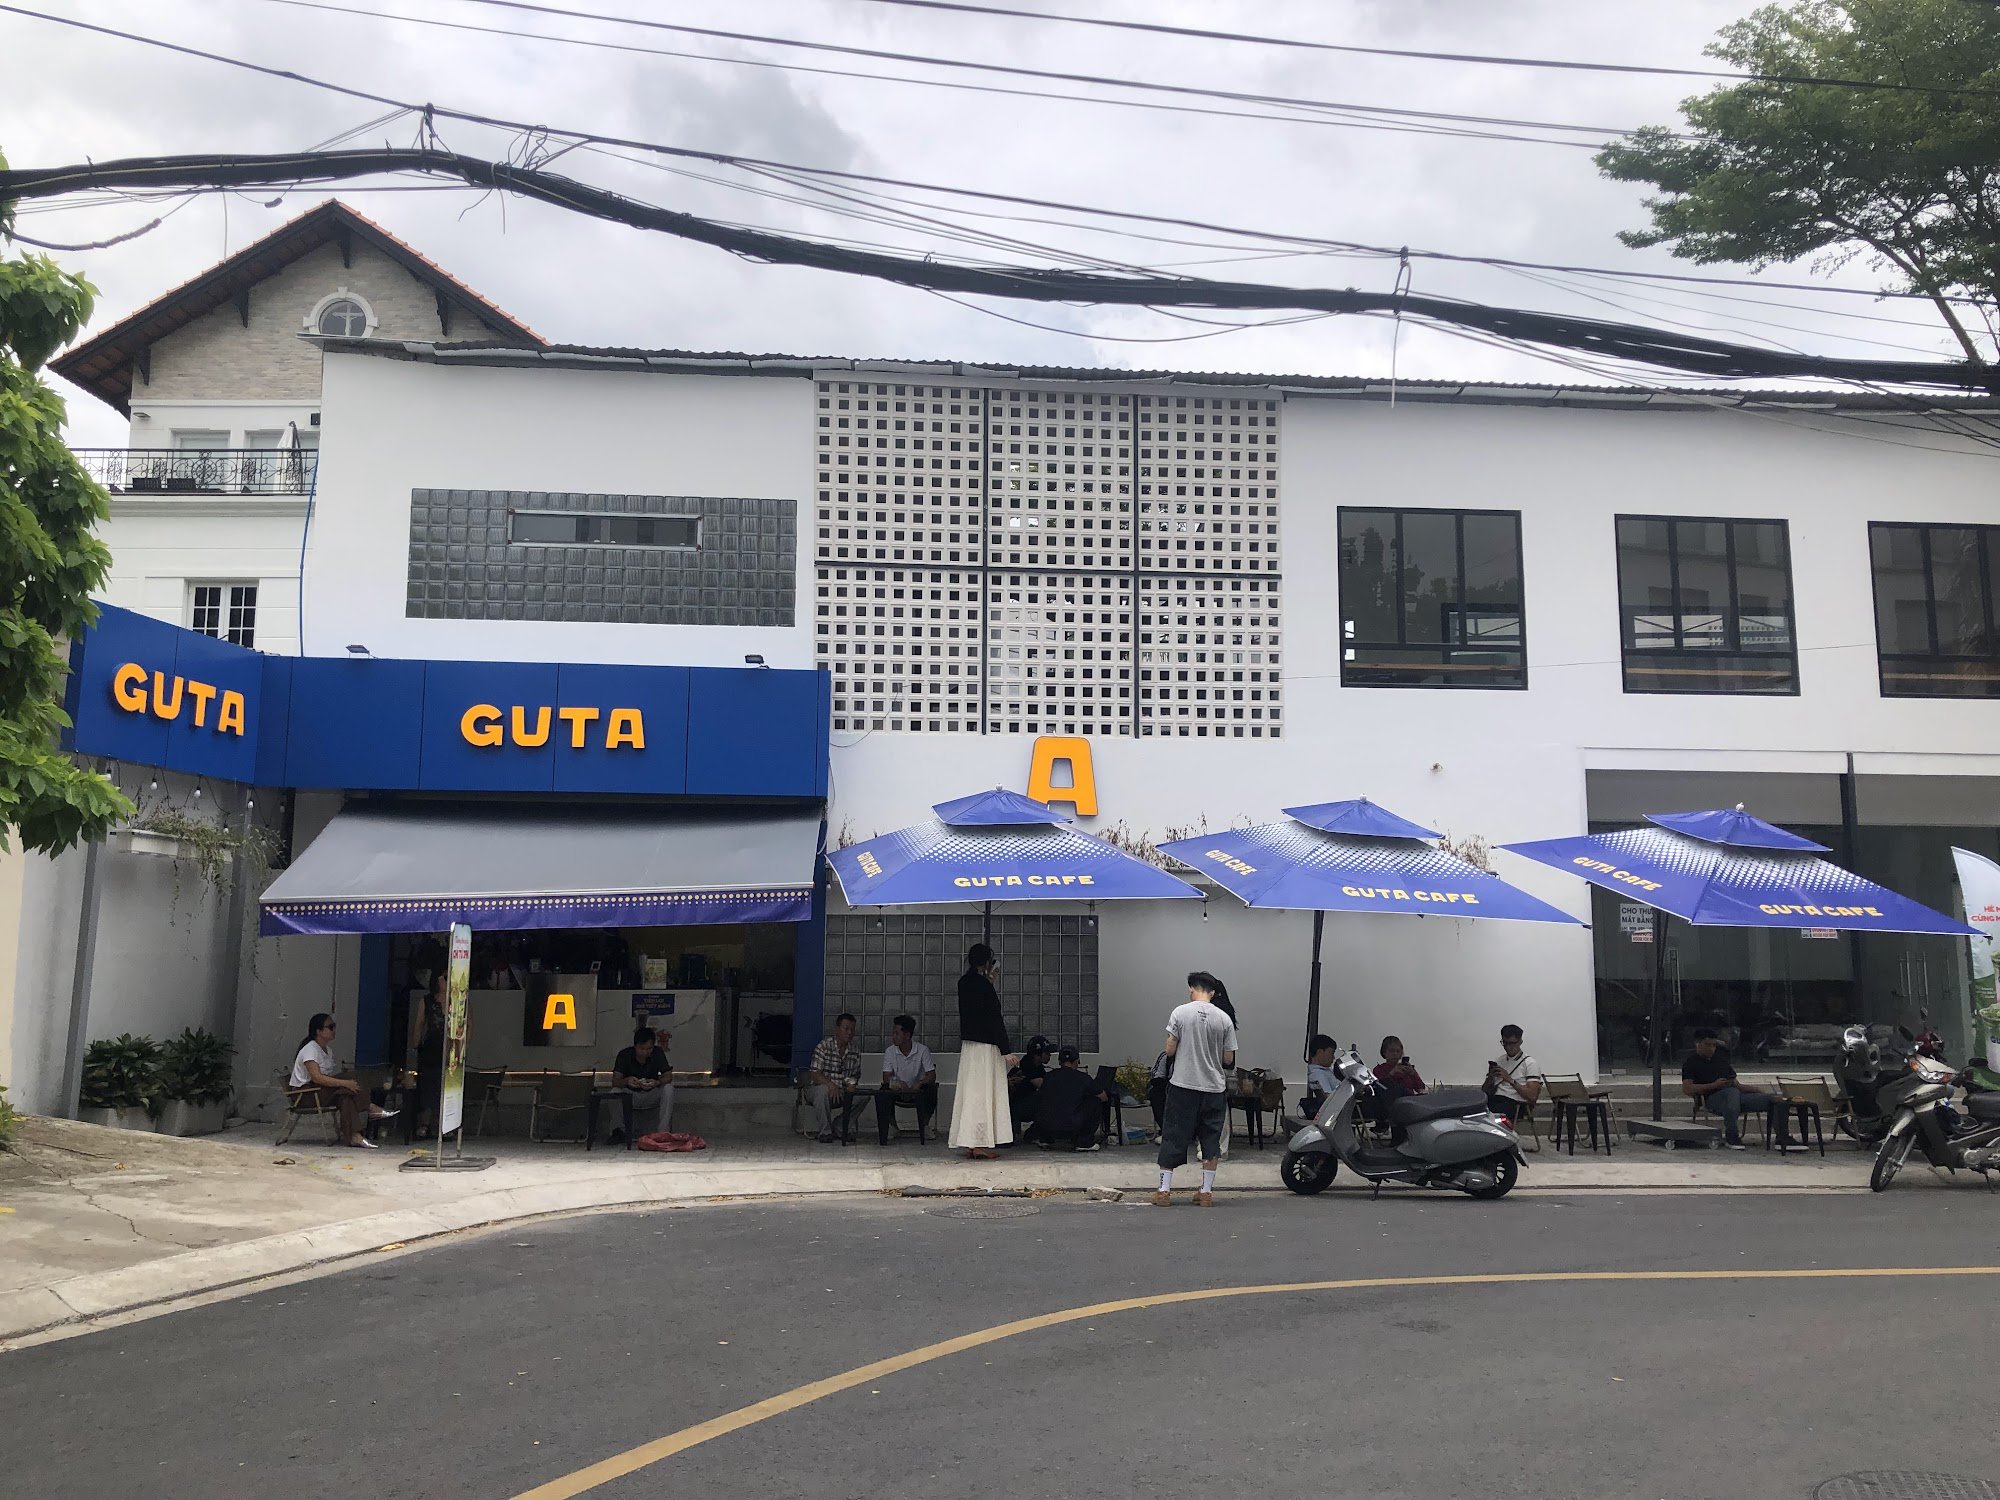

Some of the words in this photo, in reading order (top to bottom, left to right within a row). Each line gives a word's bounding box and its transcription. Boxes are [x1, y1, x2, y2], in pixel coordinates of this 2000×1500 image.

[113, 662, 245, 737] GUTA
[460, 703, 646, 750] GUTA
[1026, 735, 1099, 817] A
[1204, 849, 1234, 863] GUTA
[1224, 858, 1258, 876] CAFE
[1573, 857, 1617, 874] GUTA
[1612, 870, 1663, 891] CAFE
[953, 876, 1023, 887] GUTA
[1027, 875, 1095, 885] CAFE
[1342, 886, 1411, 900] GUTA
[1413, 890, 1480, 904] CAFE
[1621, 907, 1638, 915] CHO
[1759, 904, 1824, 916] GUTA
[1822, 906, 1884, 916] CAFE
[542, 993, 577, 1030] A
